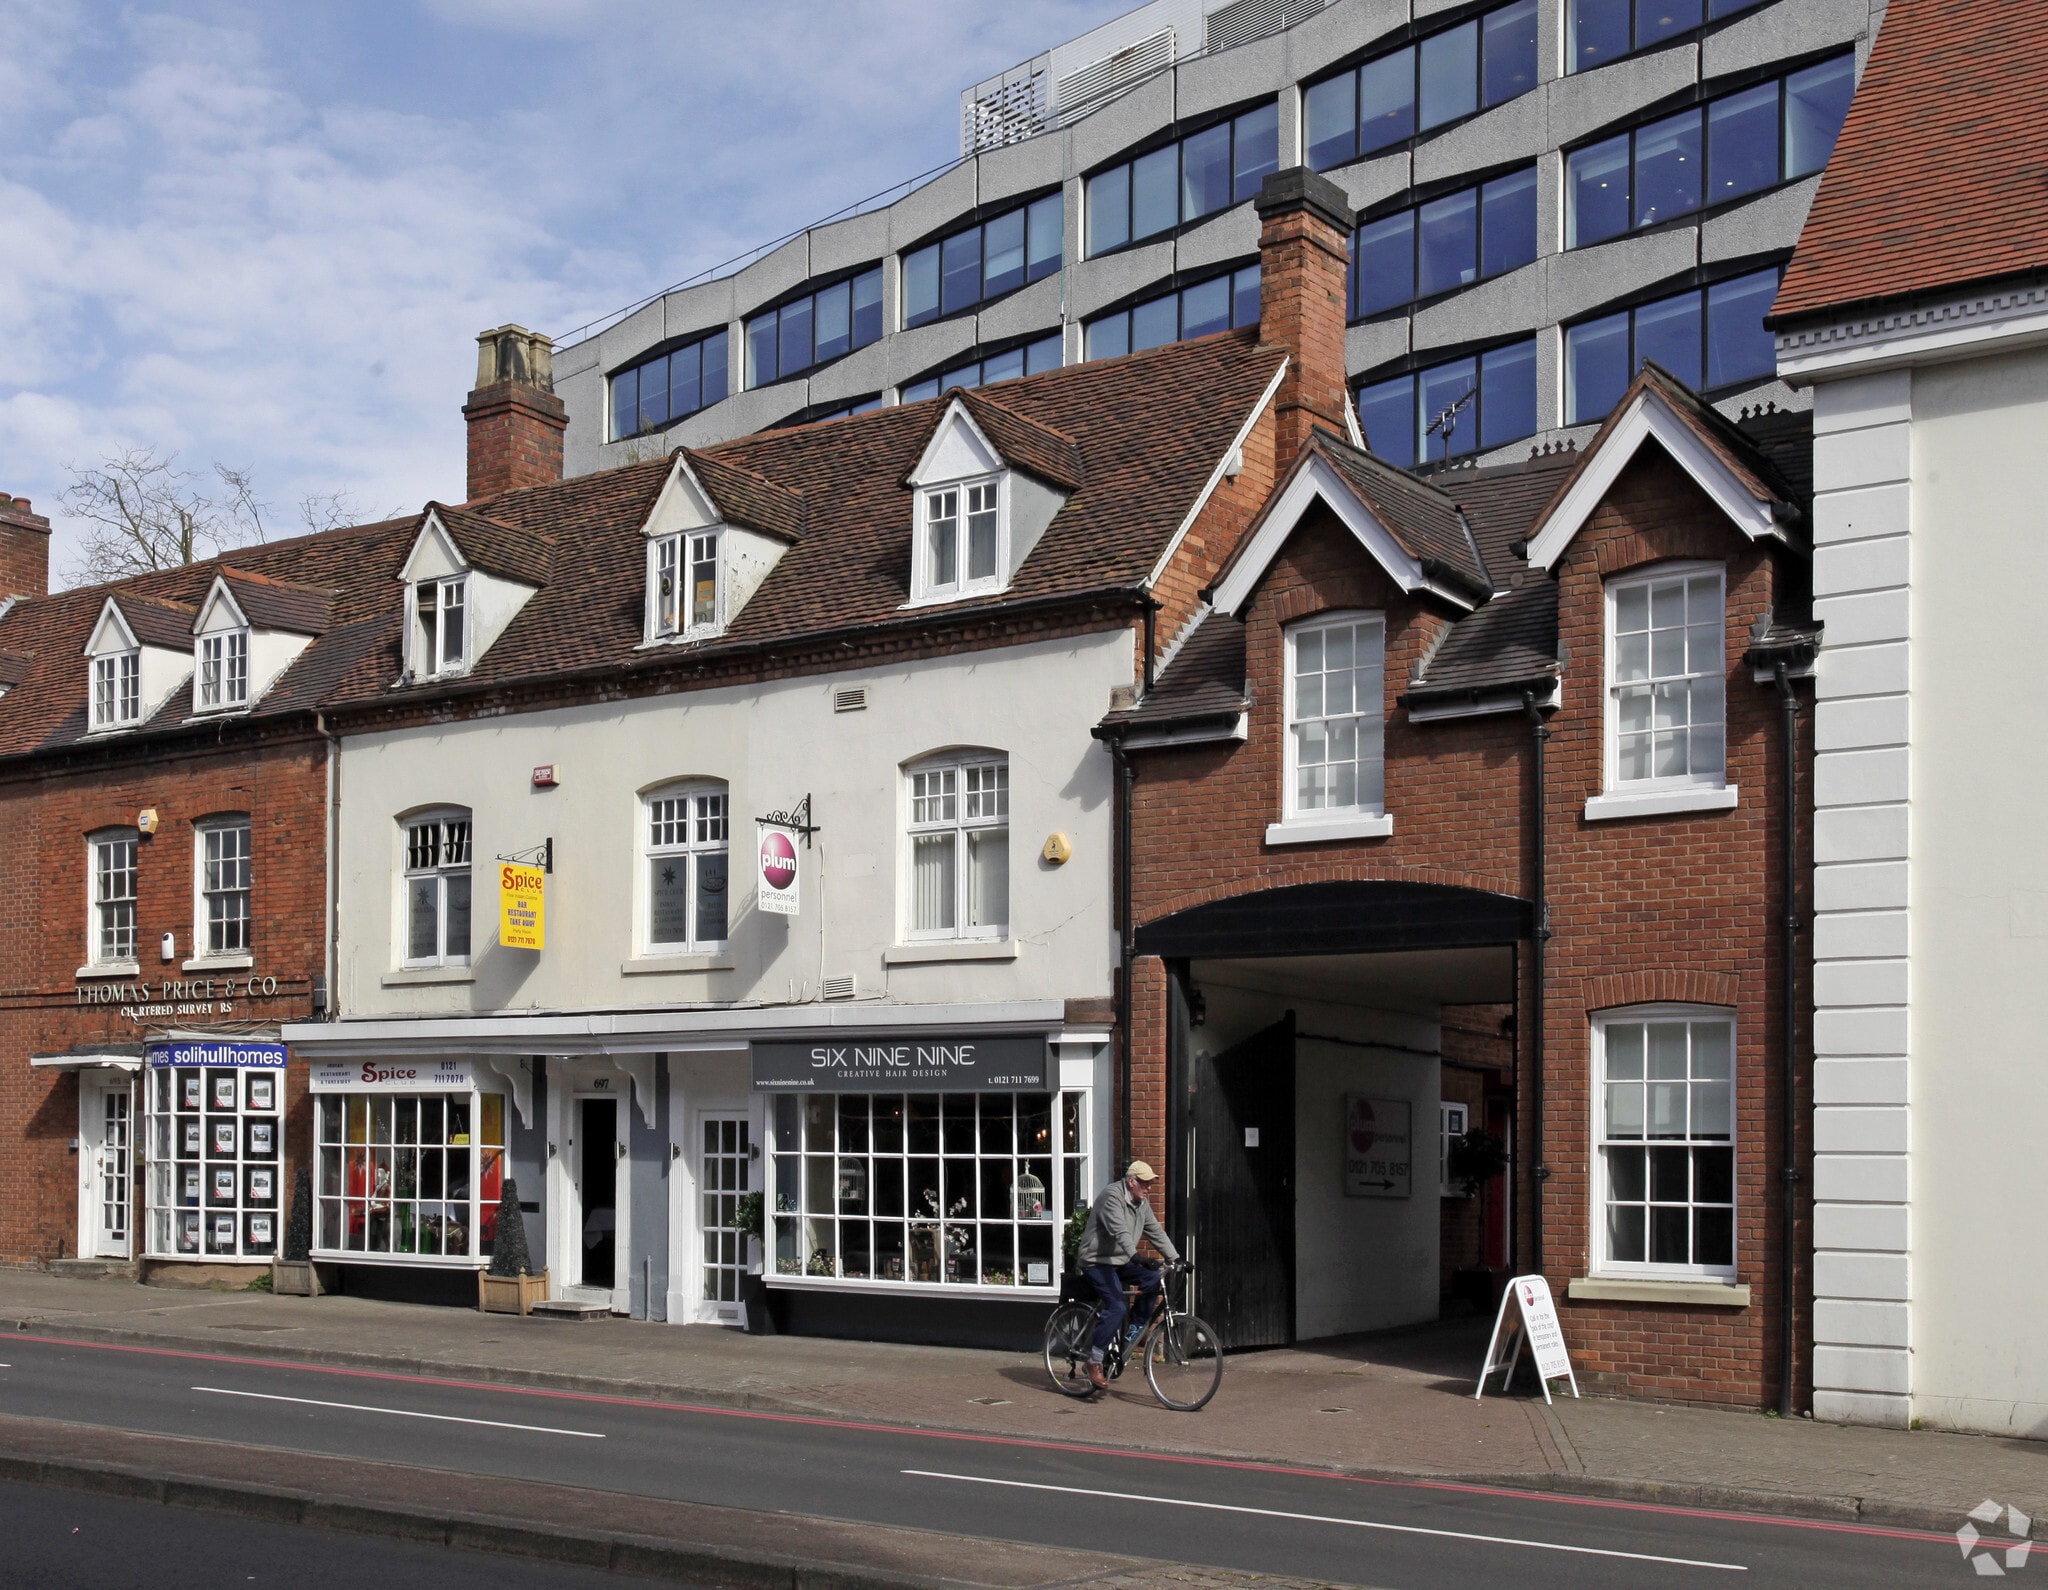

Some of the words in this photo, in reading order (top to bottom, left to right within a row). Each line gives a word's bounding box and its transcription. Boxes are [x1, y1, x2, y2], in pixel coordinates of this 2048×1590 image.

[762, 848, 796, 872] plum
[502, 867, 542, 890] Spice
[762, 890, 797, 902] personnel
[508, 909, 536, 918] RESTAURANT
[76, 982, 150, 1004] THOMAS
[163, 980, 214, 1000] PRICE
[225, 978, 236, 998] &
[248, 976, 279, 996] CO.
[120, 1006, 173, 1016] CHRTERED
[174, 1046, 283, 1064] solihullhomes
[811, 1048, 848, 1067] SIX
[855, 1047, 910, 1066] NINE
[917, 1046, 976, 1066] NINE
[361, 1062, 416, 1083] Spice
[441, 1062, 457, 1070] 0121
[434, 1074, 445, 1083] 711
[446, 1074, 464, 1083] 7070
[594, 1079, 609, 1088] 697
[1350, 1117, 1375, 1131] plum
[1349, 1160, 1367, 1174] 0121
[1370, 1161, 1386, 1175] 705
[1390, 1163, 1408, 1176] 8157
